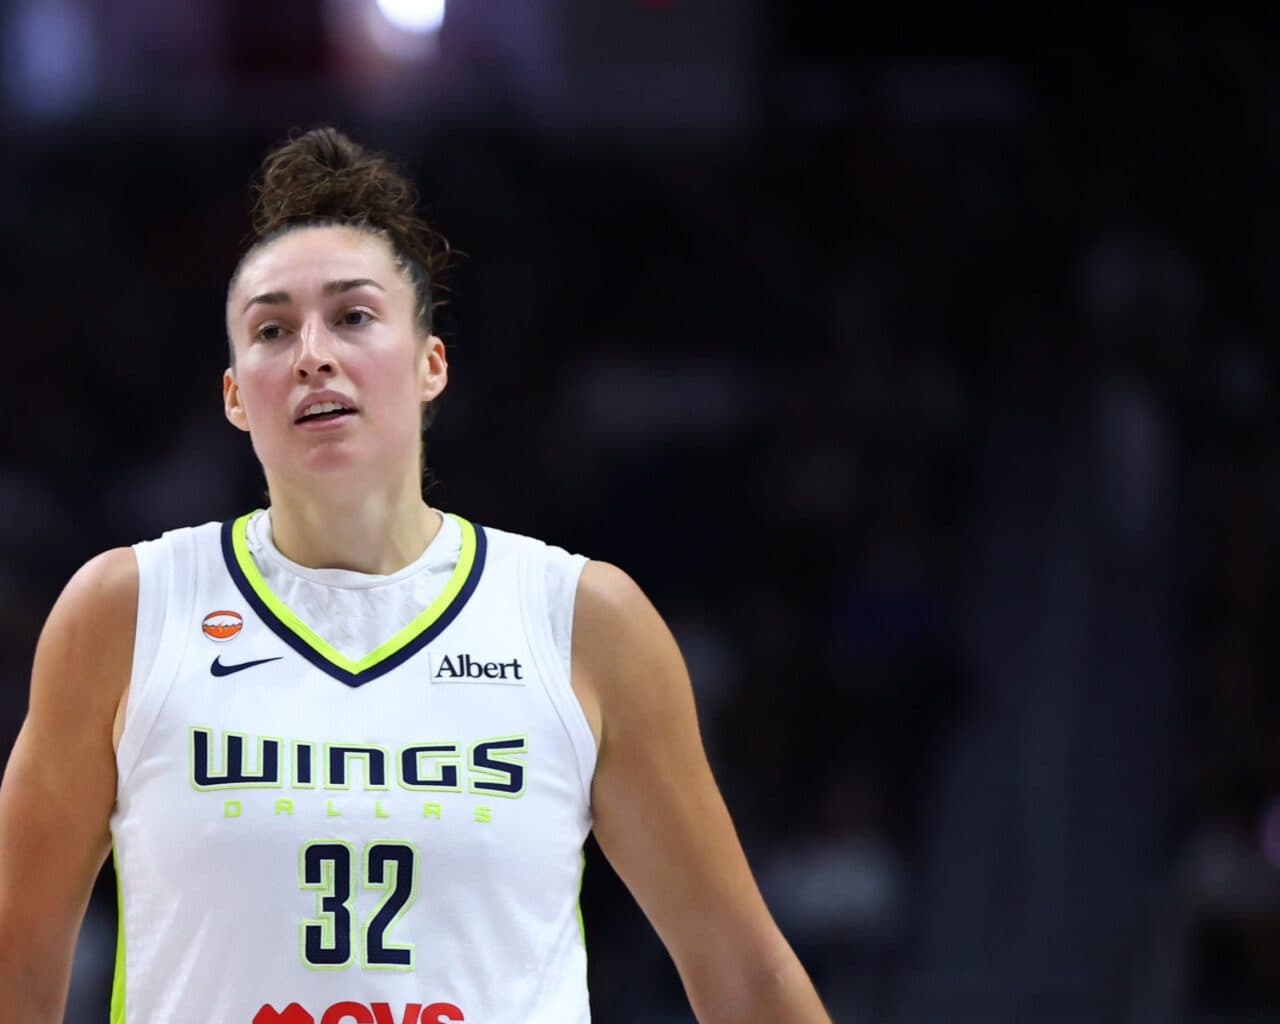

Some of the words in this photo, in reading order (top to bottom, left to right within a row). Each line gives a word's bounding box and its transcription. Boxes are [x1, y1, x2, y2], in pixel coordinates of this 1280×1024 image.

[436, 654, 522, 680] Albert
[224, 798, 491, 823] DALLAS
[299, 839, 419, 971] 32
